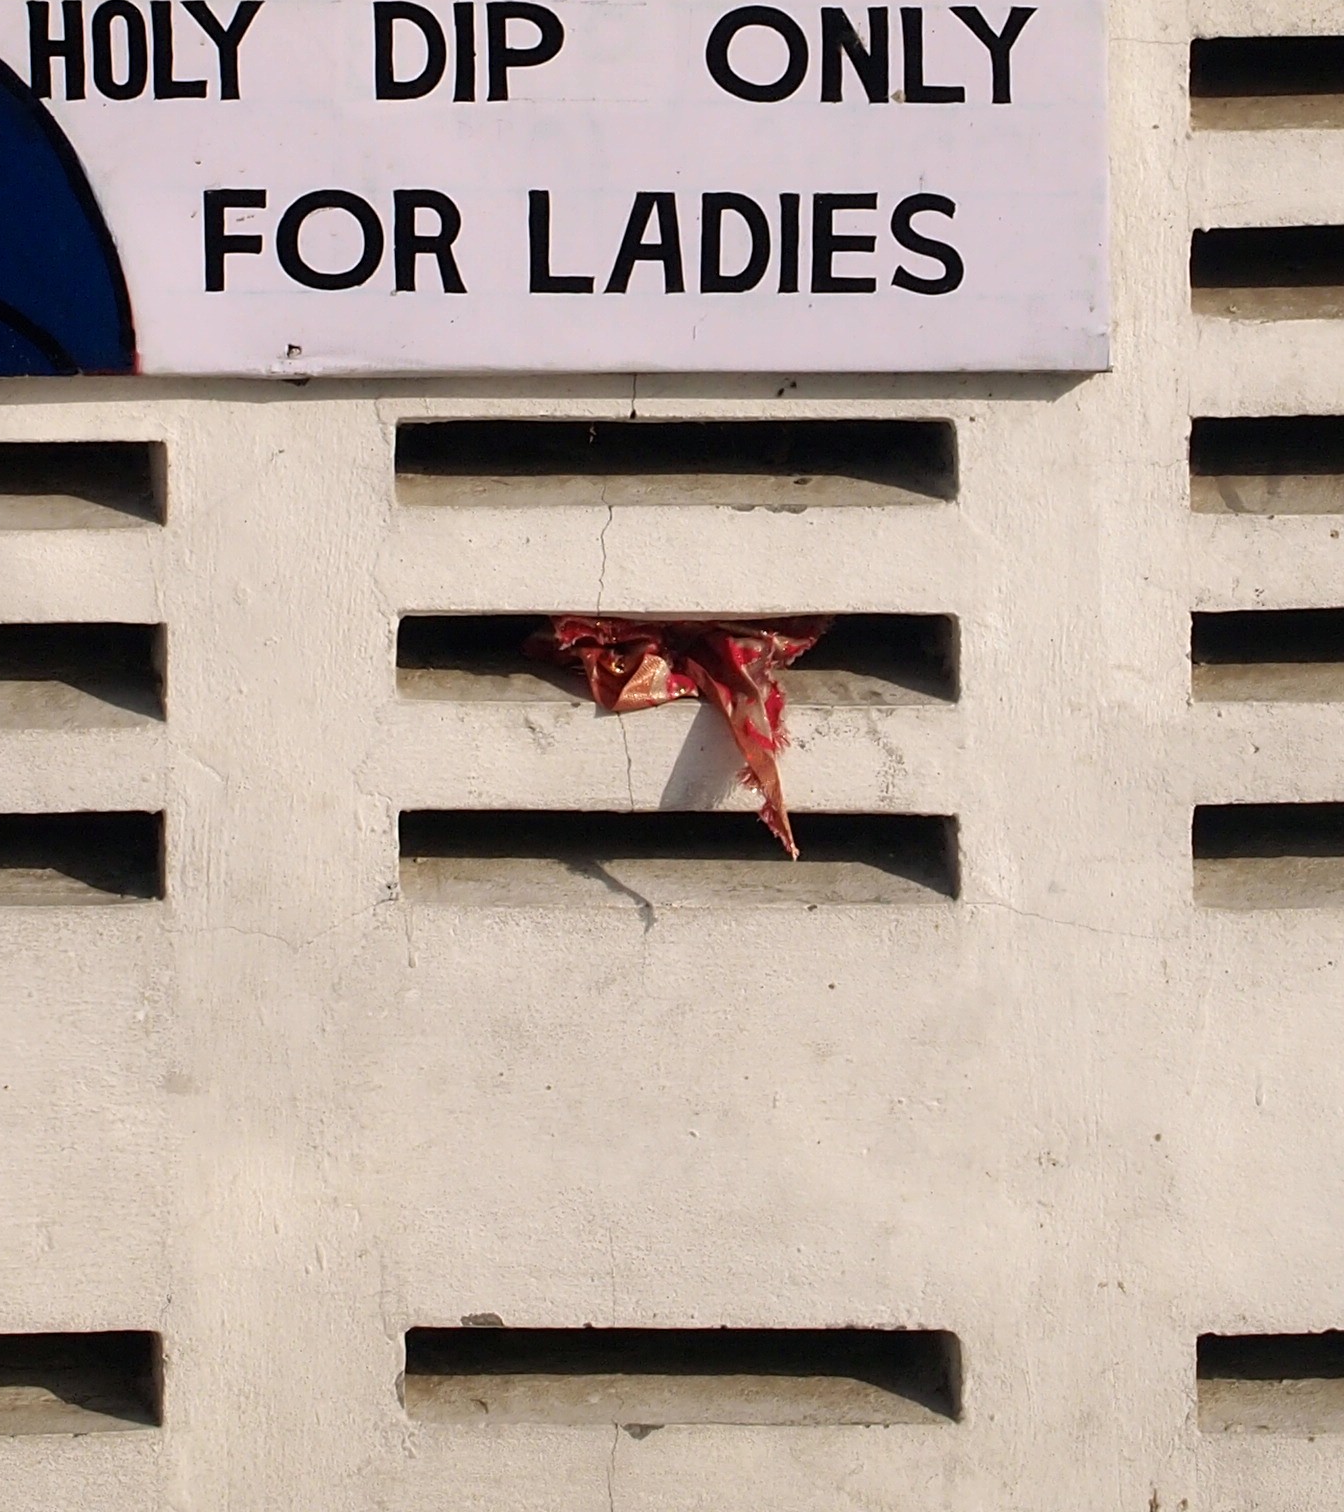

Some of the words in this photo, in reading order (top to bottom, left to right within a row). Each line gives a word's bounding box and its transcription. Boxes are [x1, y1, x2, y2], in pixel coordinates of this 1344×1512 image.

[28, 0, 264, 102] HOLY
[374, 0, 565, 103] DIP
[706, 5, 1038, 105] ONLY
[204, 188, 467, 294] FOR
[529, 189, 965, 295] LADIES
